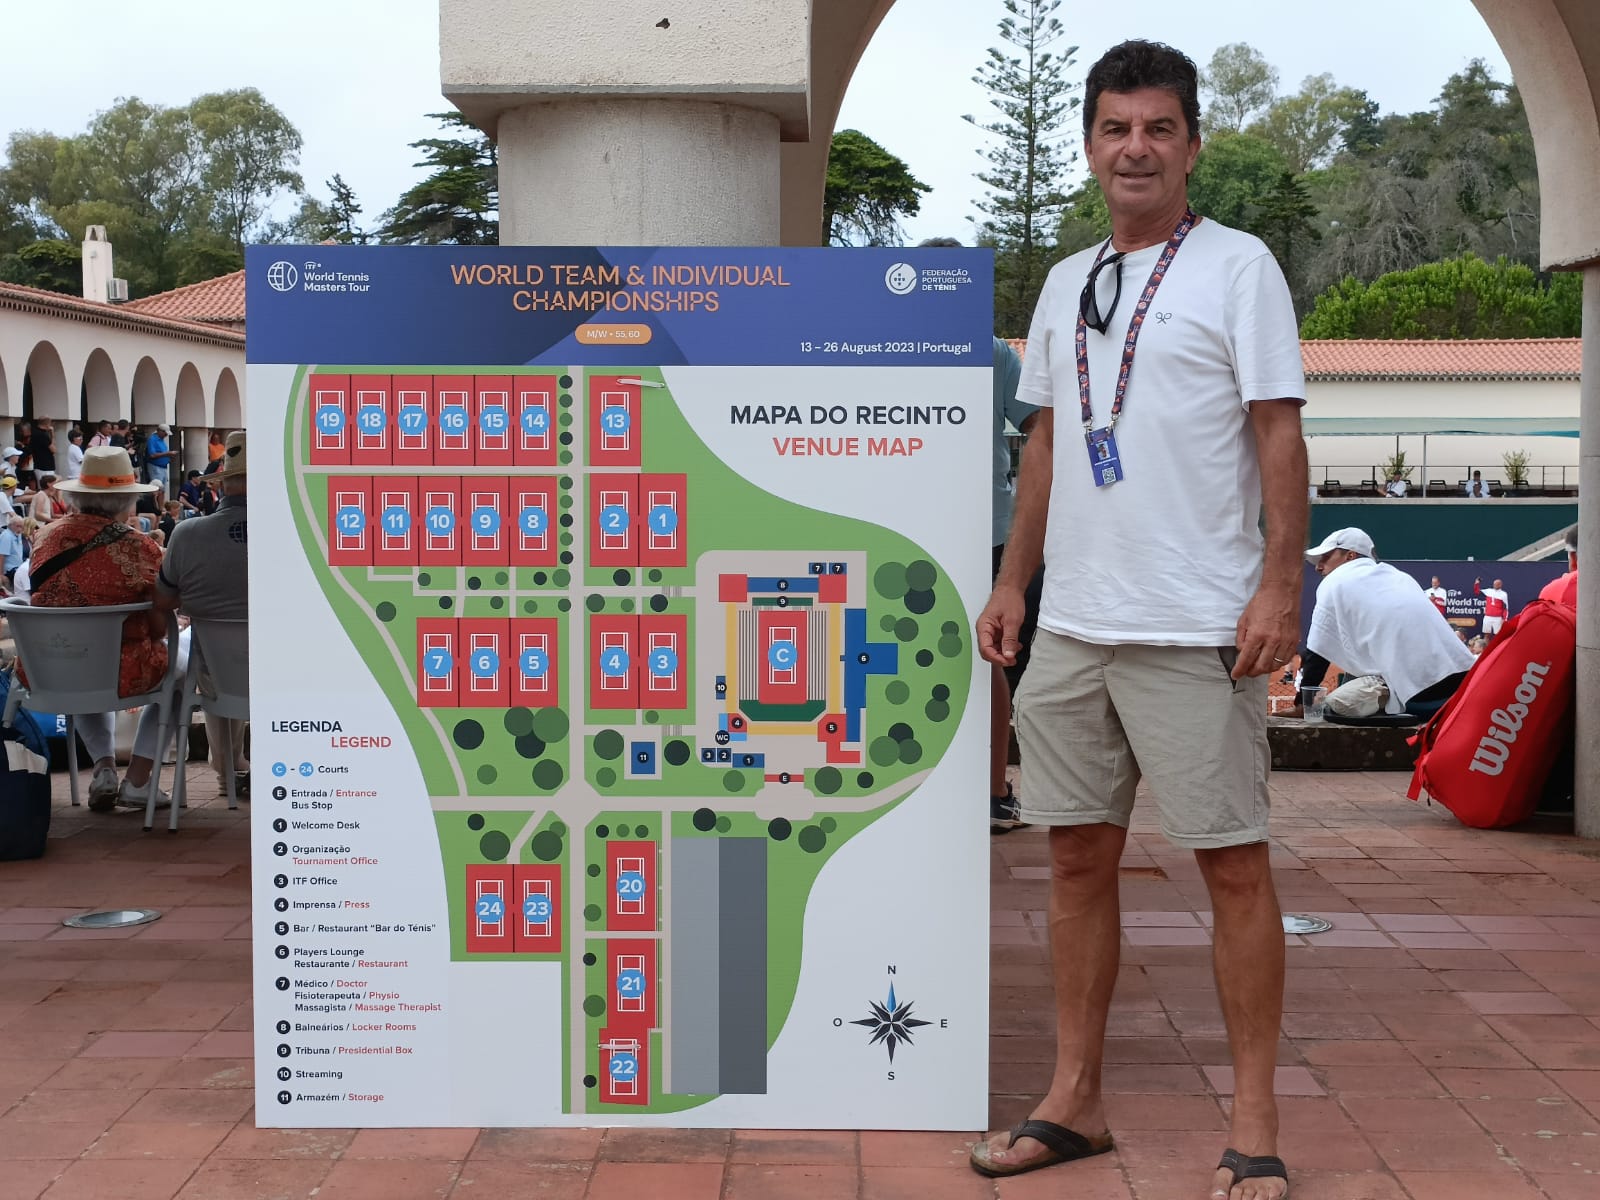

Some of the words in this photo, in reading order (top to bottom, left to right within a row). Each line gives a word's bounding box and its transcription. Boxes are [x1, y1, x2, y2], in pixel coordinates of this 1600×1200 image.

[304, 272, 335, 281] World
[336, 272, 369, 281] Tennis
[450, 265, 544, 286] WORLD
[550, 265, 620, 286] TEAM
[626, 265, 645, 286] &
[652, 265, 791, 287] INDIVIDUAL
[304, 282, 346, 292] Masters
[348, 282, 370, 292] Tour
[512, 290, 719, 312] CHAMPIONSHIPS
[587, 330, 607, 338] M/W
[628, 330, 640, 338] 60
[801, 342, 811, 352] 13
[824, 342, 838, 352] 26
[841, 342, 882, 355] August
[884, 342, 914, 352] 2023
[923, 342, 972, 355] Portugal
[320, 413, 340, 427] 19
[361, 413, 381, 427] 18
[403, 413, 422, 427] 17
[444, 413, 464, 427] 16
[484, 413, 504, 427] 15
[525, 413, 545, 428] 14
[606, 413, 625, 428] 13
[731, 405, 802, 425] MAPA
[810, 405, 848, 425] DO
[856, 405, 966, 425] RECINTO
[772, 437, 859, 456] VENUE
[867, 437, 923, 456] MAP
[340, 514, 360, 528] 12
[387, 514, 404, 528] 11
[430, 514, 450, 528] 10
[479, 514, 492, 528] 9
[527, 514, 539, 529] 8
[608, 513, 620, 527] 2
[658, 513, 667, 527] 1
[1447, 598, 1472, 606] World
[609, 654, 621, 669] 4
[657, 654, 668, 669] 3
[776, 648, 790, 663] C
[433, 655, 443, 670] 7
[479, 655, 490, 670] 6
[528, 655, 539, 670] 5
[1468, 662, 1550, 776] Wilson
[271, 721, 342, 733] LEGENDA
[331, 736, 391, 748] LEGEND
[318, 766, 349, 774] Courts
[292, 789, 327, 798] Entrada
[336, 789, 377, 797] Entrance
[312, 801, 333, 811] Stop
[292, 821, 334, 830] Welcome
[337, 821, 360, 830] Desk
[292, 845, 351, 855] Organização
[292, 857, 348, 865] Tournament
[350, 857, 378, 865] Office
[293, 877, 307, 885] ITF
[310, 877, 338, 885] Office
[619, 880, 642, 893] 20
[293, 901, 335, 910] Imprensa
[344, 901, 370, 909] Press
[479, 902, 501, 915] 24
[526, 902, 548, 915] 23
[294, 925, 309, 933] Bar
[318, 924, 368, 932] Restaurant
[294, 948, 328, 958] Players
[330, 948, 365, 958] Lounge
[294, 960, 349, 968] Restaurante
[358, 960, 408, 968] Restaurant
[888, 965, 896, 974] N
[294, 980, 328, 988] Médico
[336, 980, 367, 988] Doctor
[621, 977, 641, 991] 21
[295, 992, 360, 1001] Fisioterapeuta
[369, 992, 399, 1001] Physio
[295, 1004, 346, 1013] Massagista
[355, 1004, 395, 1013] Massage
[398, 1003, 441, 1012] Therapist
[295, 1023, 344, 1031] Balneários
[352, 1023, 383, 1031] Locker
[385, 1023, 416, 1031] Rooms
[833, 1018, 842, 1027] O
[941, 1019, 947, 1028] E
[296, 1047, 330, 1055] Tribuna
[338, 1046, 393, 1055] Presidential
[395, 1046, 412, 1054] Box
[612, 1060, 634, 1075] 22
[296, 1070, 343, 1080] Streaming
[887, 1072, 895, 1080] S
[296, 1093, 339, 1101] Armazém
[349, 1093, 384, 1102] Storage
